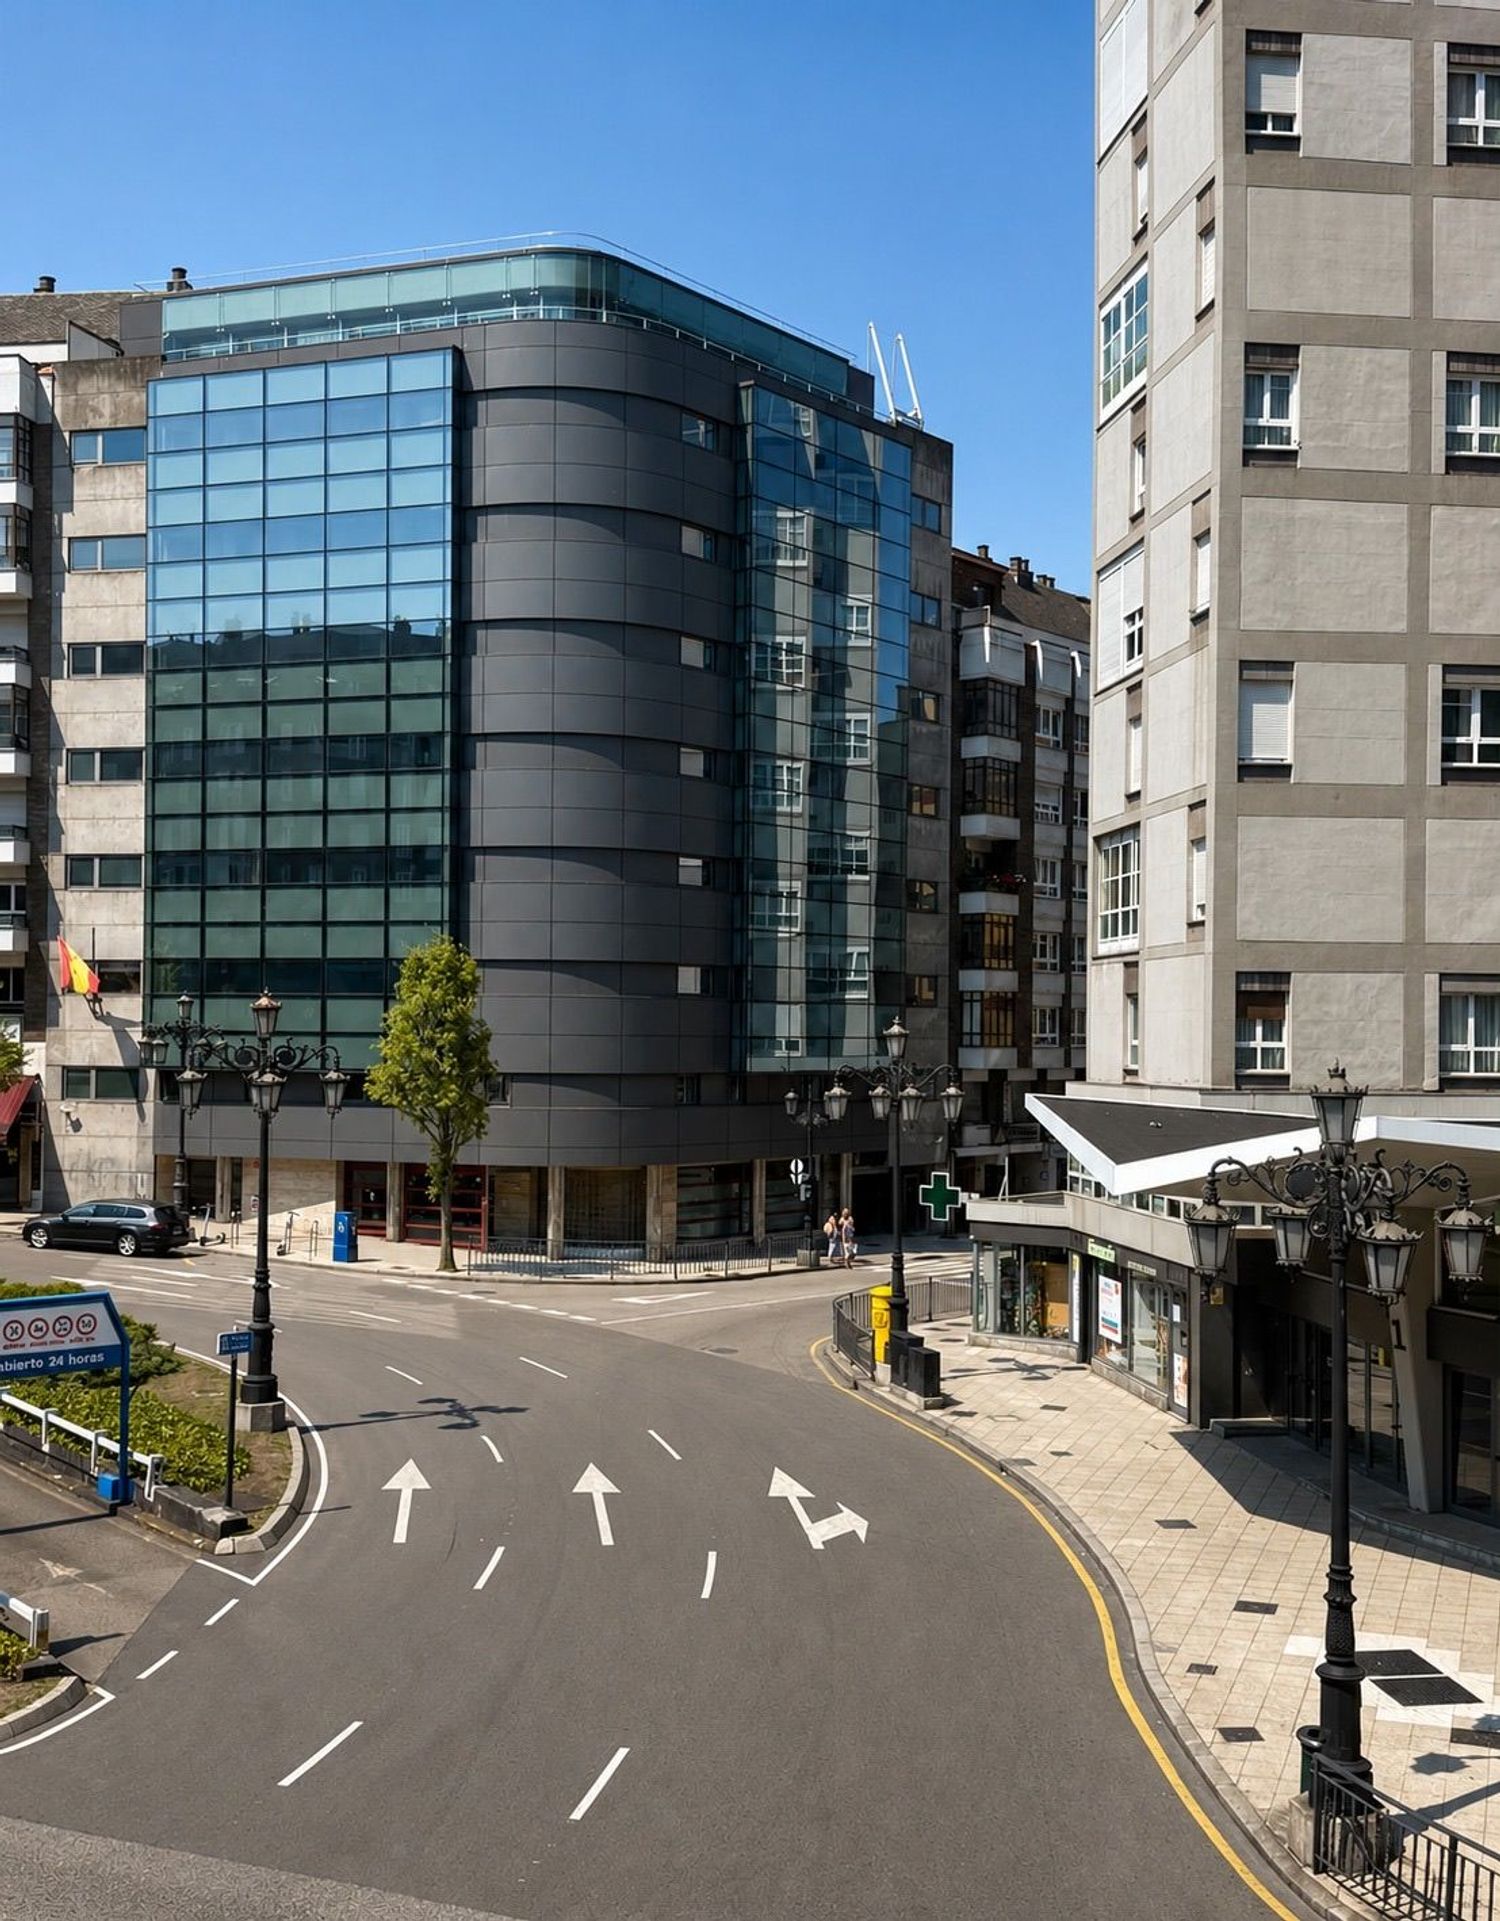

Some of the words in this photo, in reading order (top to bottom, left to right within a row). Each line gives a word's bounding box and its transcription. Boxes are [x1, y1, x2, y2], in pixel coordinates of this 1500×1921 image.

[1392, 1319, 1406, 1351] 1
[48, 1355, 64, 1367] 24
[68, 1353, 104, 1365] horas
